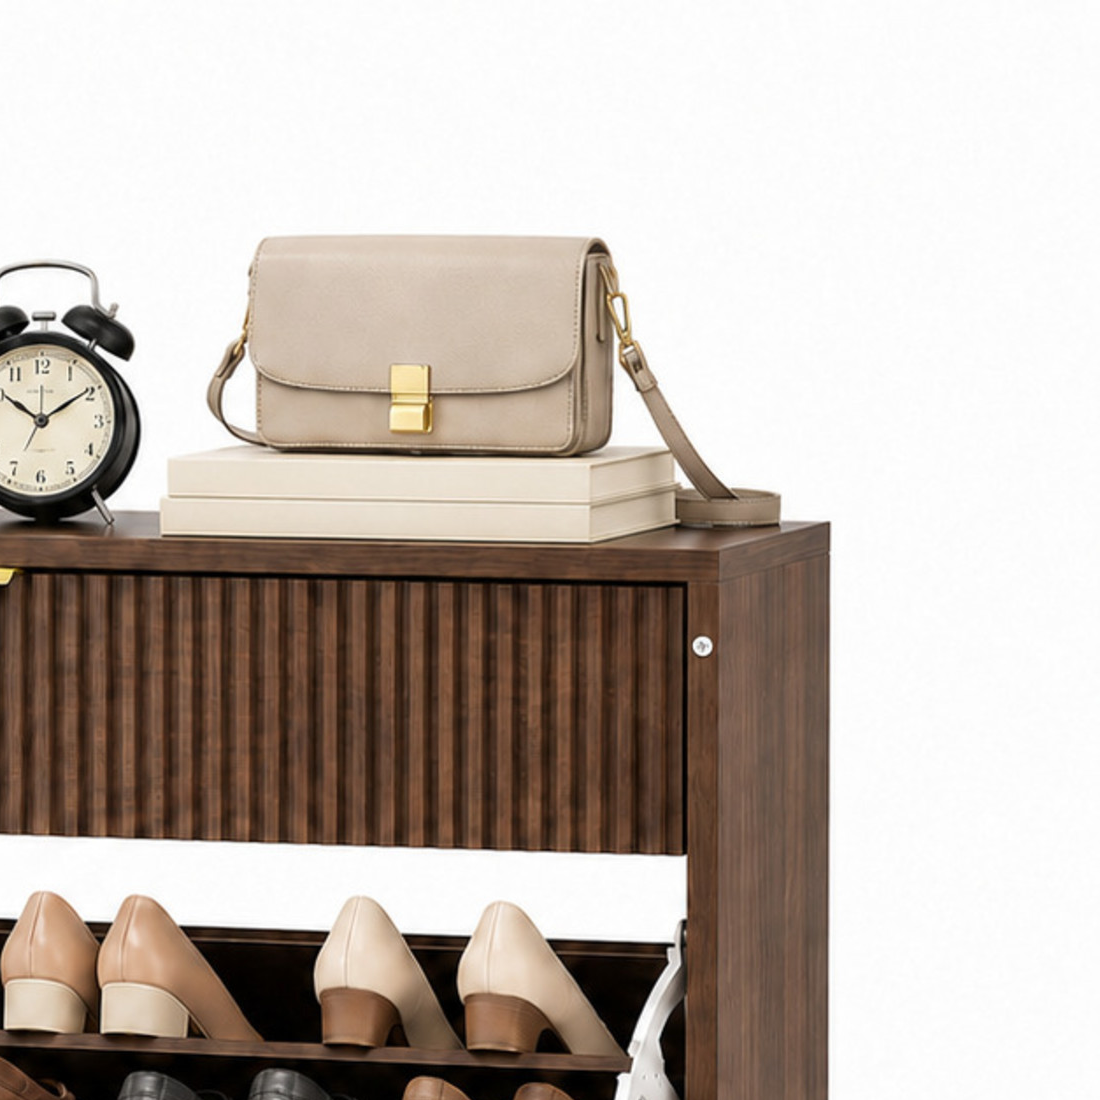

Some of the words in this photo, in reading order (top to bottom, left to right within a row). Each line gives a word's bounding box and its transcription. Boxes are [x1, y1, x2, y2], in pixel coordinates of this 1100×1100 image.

[35, 359, 50, 374] 12
[67, 365, 73, 381] 1
[10, 367, 21, 382] 11
[85, 386, 96, 402] 2
[94, 415, 104, 428] 3
[84, 442, 94, 456] 4
[10, 461, 18, 476] 7
[66, 461, 75, 475] 5
[36, 470, 45, 484] 6
